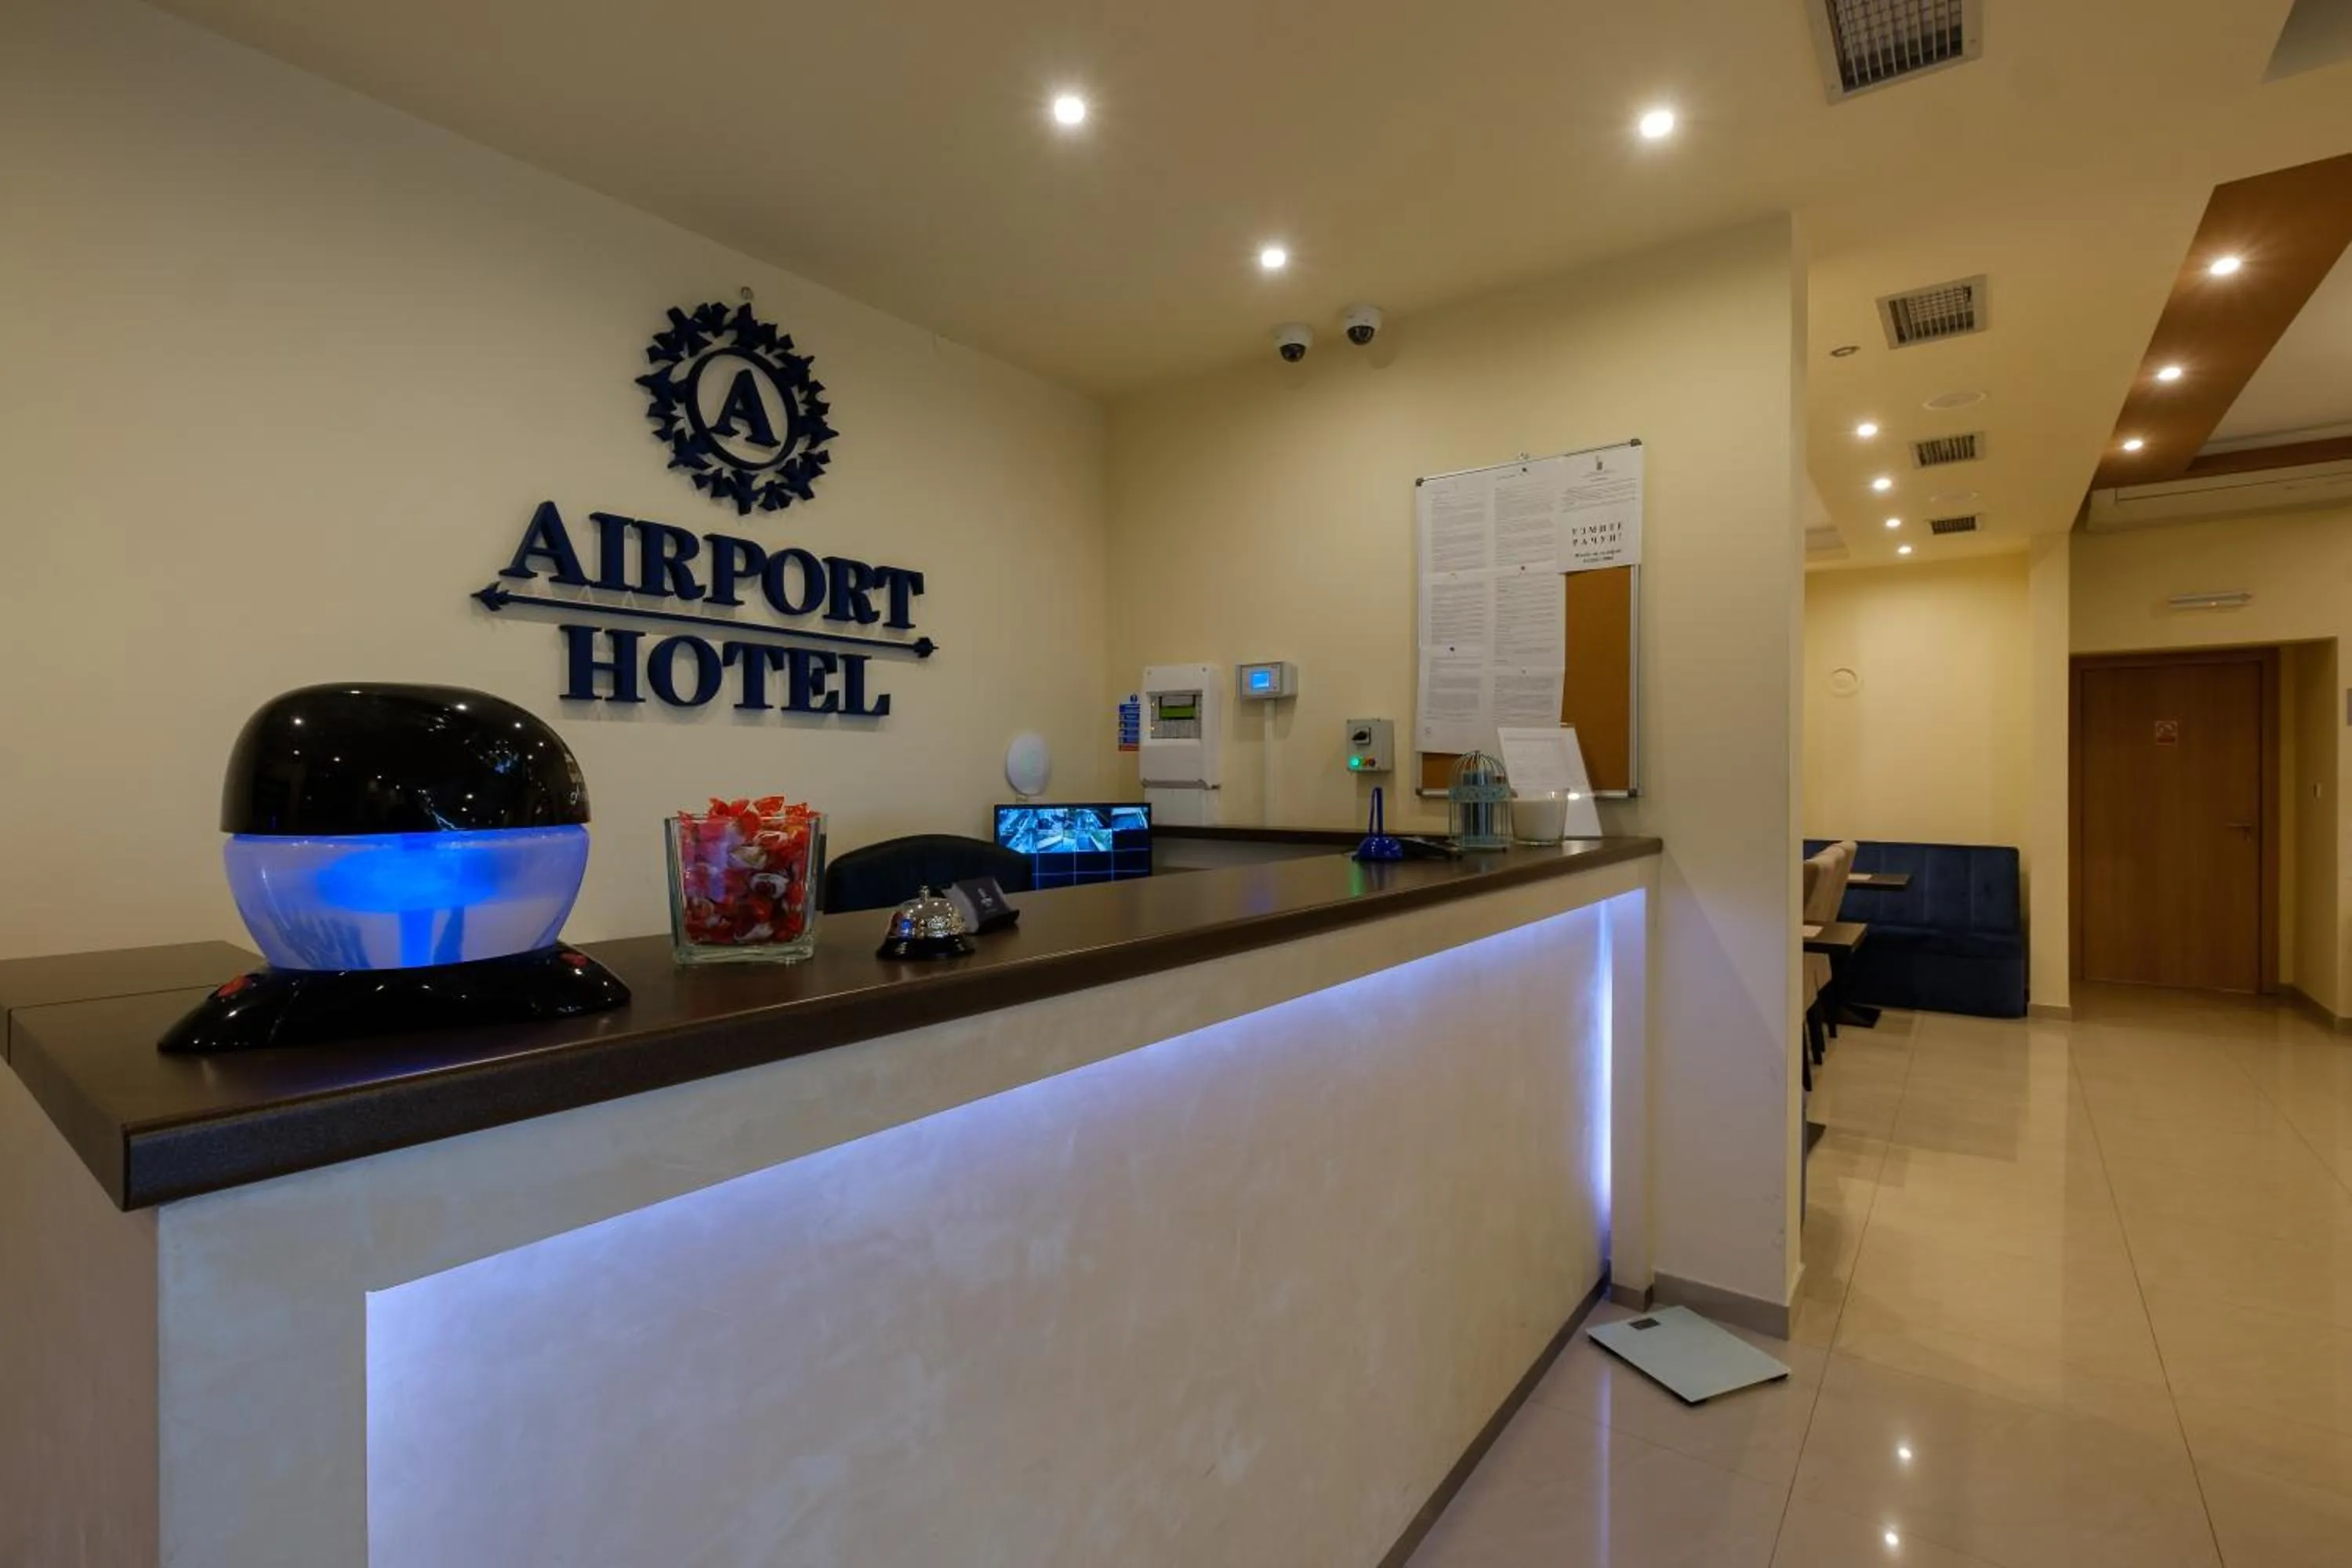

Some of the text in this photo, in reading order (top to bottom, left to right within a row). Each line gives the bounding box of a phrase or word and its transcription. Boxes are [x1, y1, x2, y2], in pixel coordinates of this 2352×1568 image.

[710, 370, 780, 447] A
[499, 501, 924, 630] AIRPORT
[558, 624, 891, 717] HOTEL
